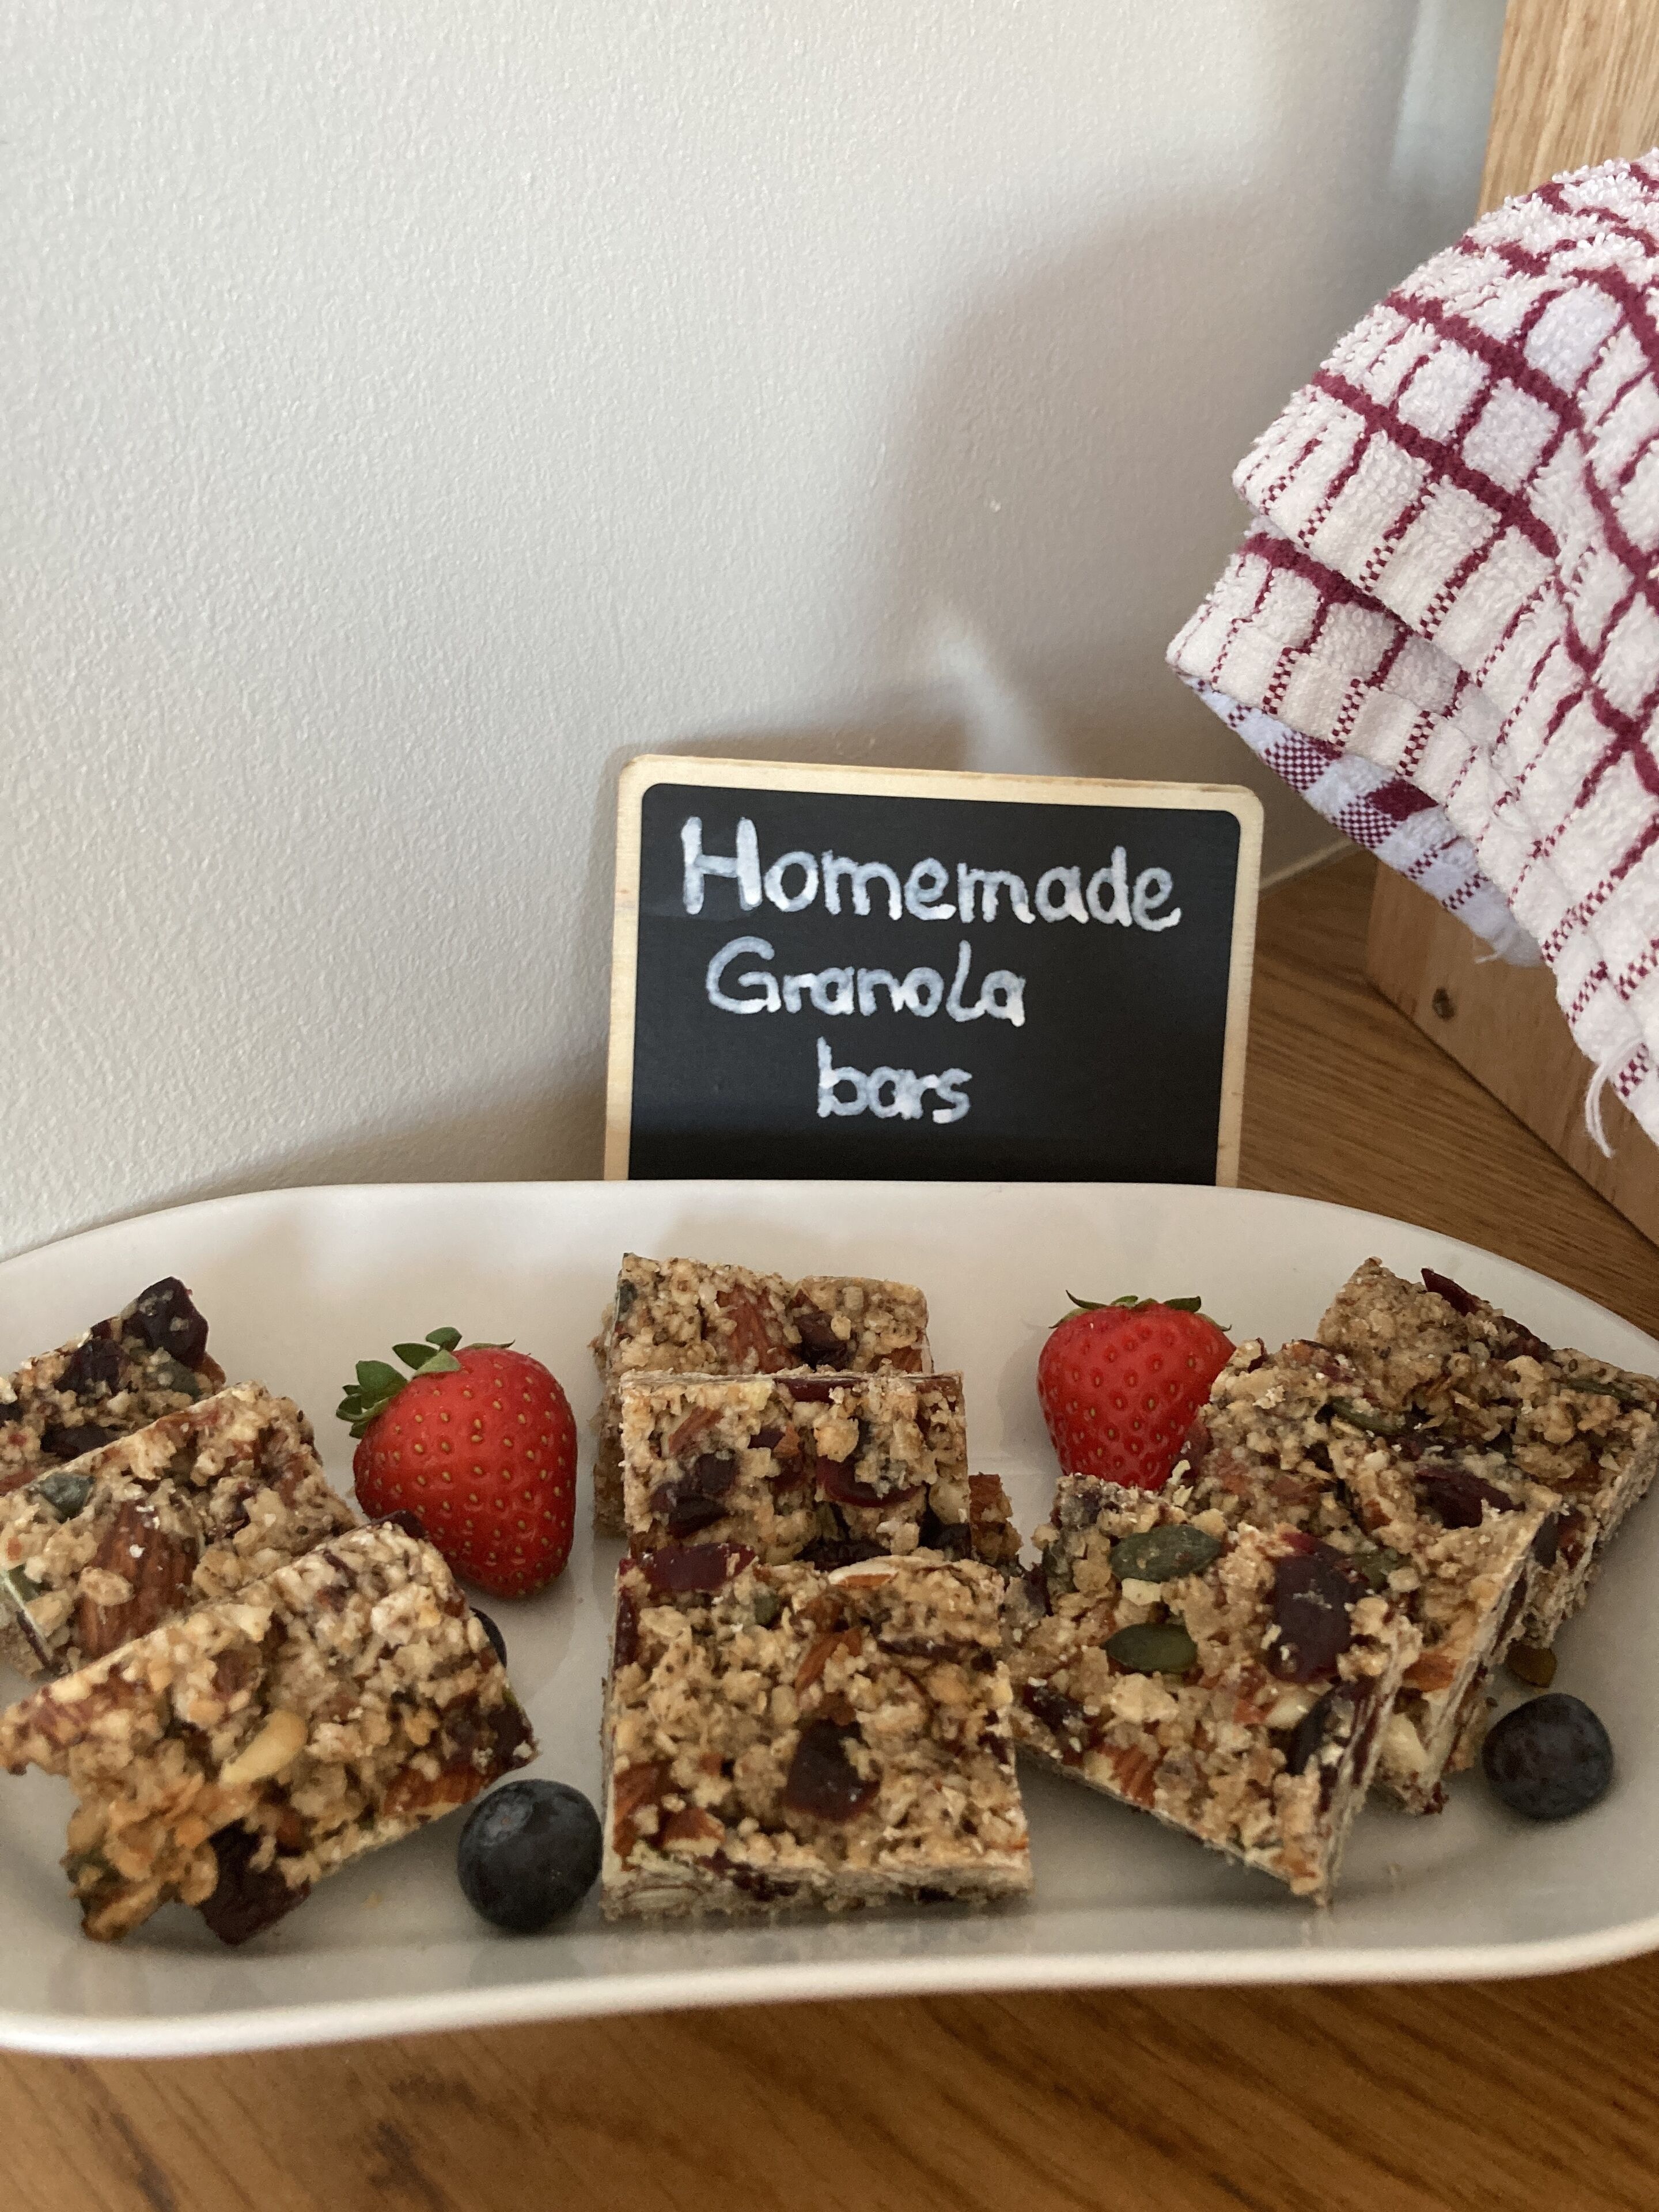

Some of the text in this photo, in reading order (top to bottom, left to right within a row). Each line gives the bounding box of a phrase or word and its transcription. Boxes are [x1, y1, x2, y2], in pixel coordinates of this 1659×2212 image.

[680, 816, 1181, 932] Homemade
[705, 935, 1027, 1027] Granola
[816, 1036, 973, 1124] bars
